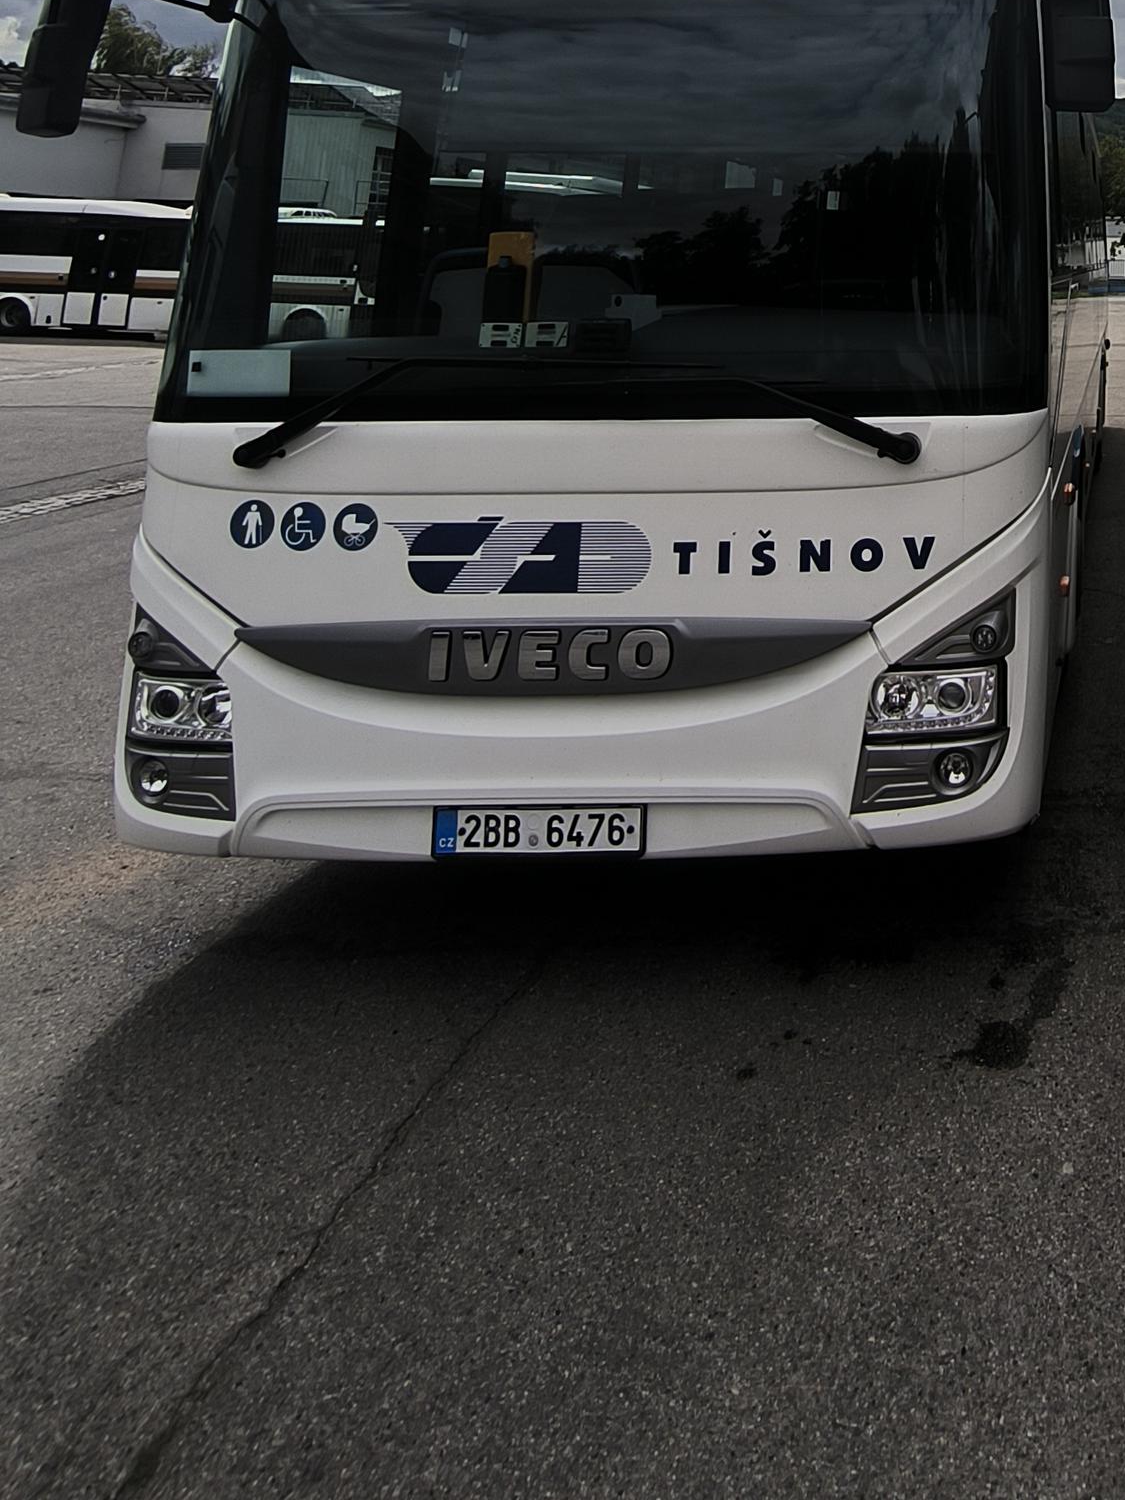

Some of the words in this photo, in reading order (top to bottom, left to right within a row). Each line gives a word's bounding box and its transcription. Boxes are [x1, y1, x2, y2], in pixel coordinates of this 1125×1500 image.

[672, 529, 936, 576] TIŠNOV
[427, 628, 674, 682] IVECO
[438, 837, 455, 848] CZ
[463, 814, 521, 848] 2BB
[546, 813, 625, 847] 6476
